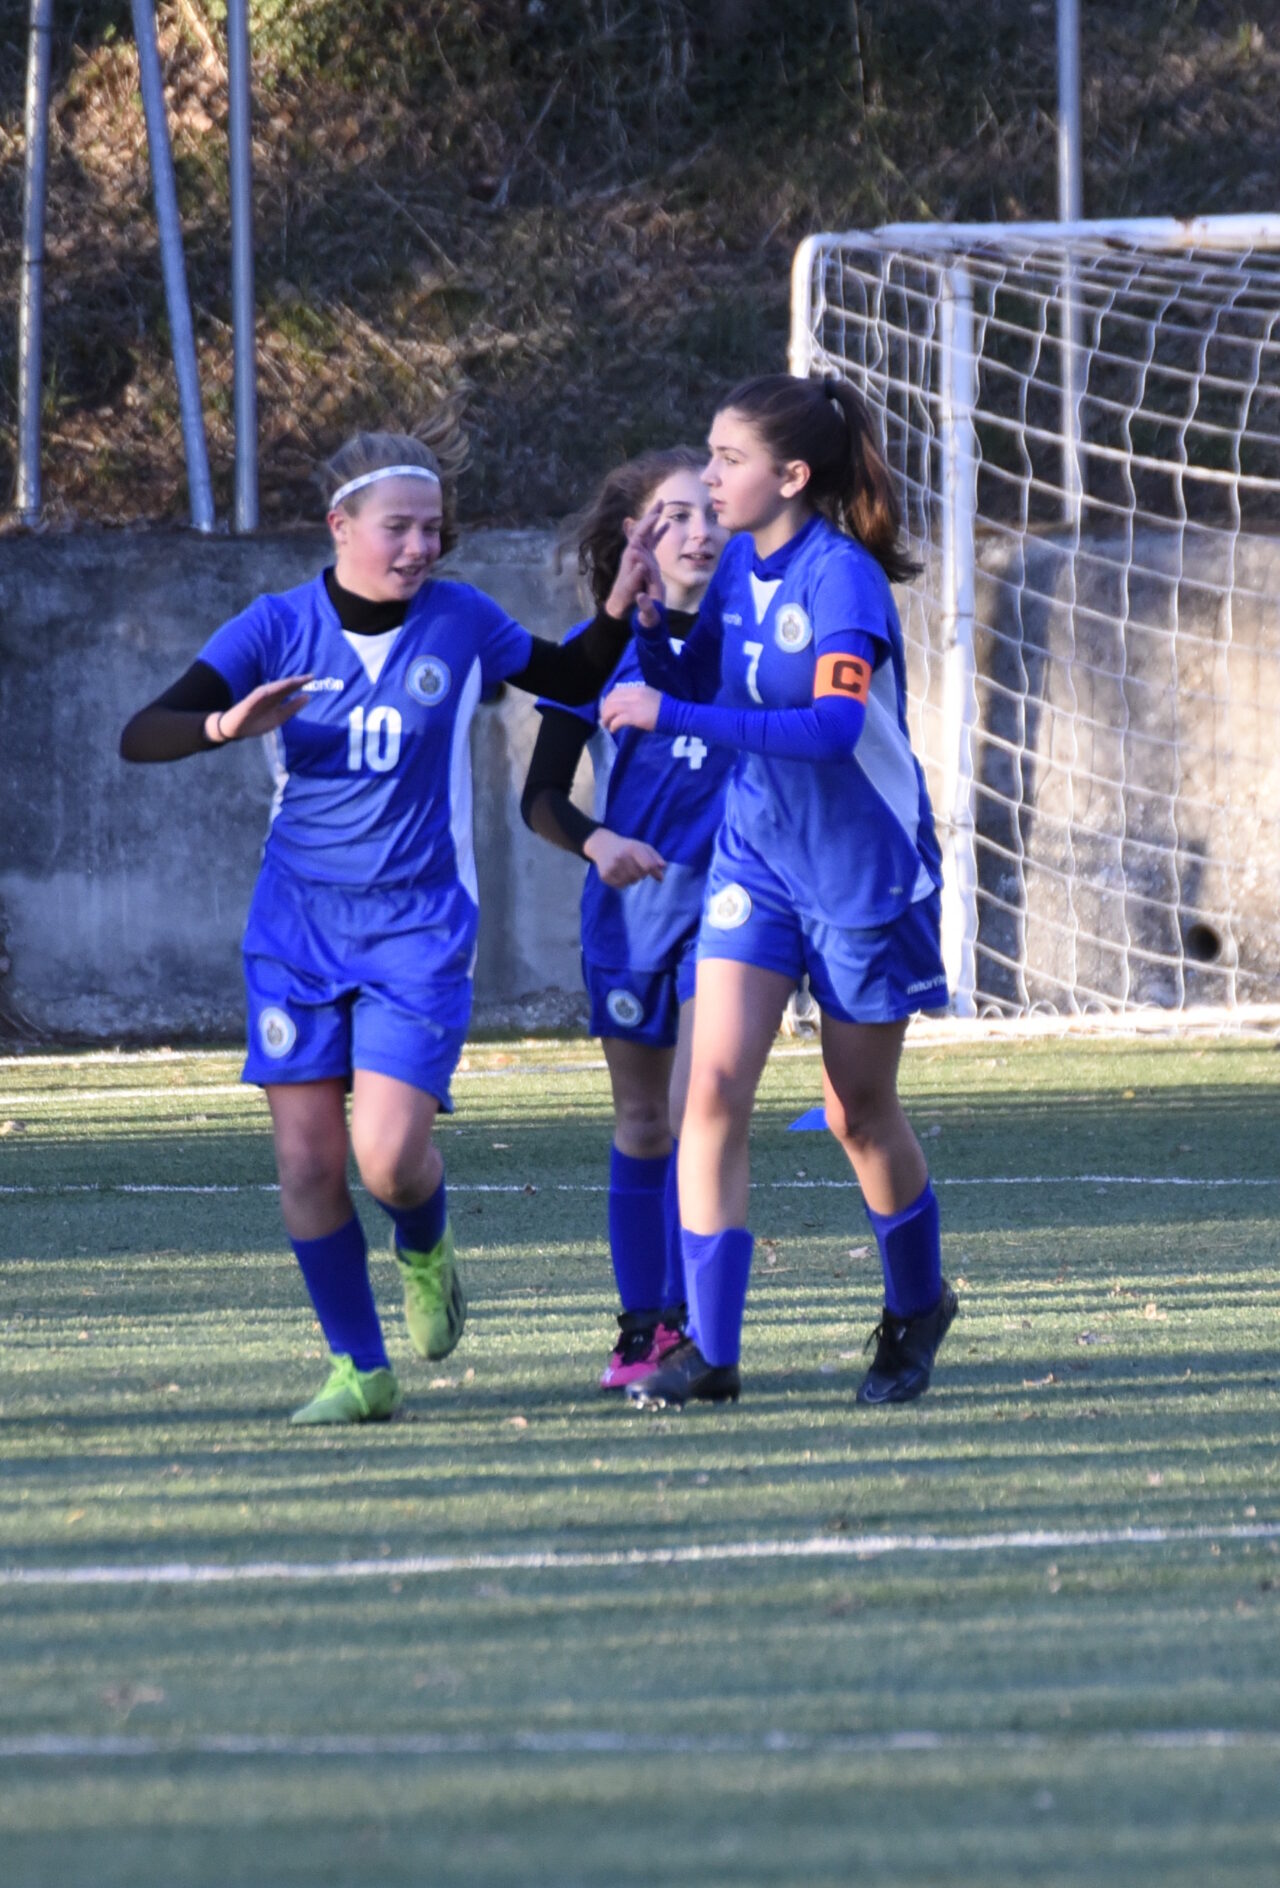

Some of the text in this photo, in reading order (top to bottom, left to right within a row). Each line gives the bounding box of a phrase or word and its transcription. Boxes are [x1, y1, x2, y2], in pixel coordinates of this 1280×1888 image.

[742, 641, 765, 705] 7
[832, 660, 863, 694] C
[348, 705, 402, 772] 10
[672, 735, 707, 770] 4
